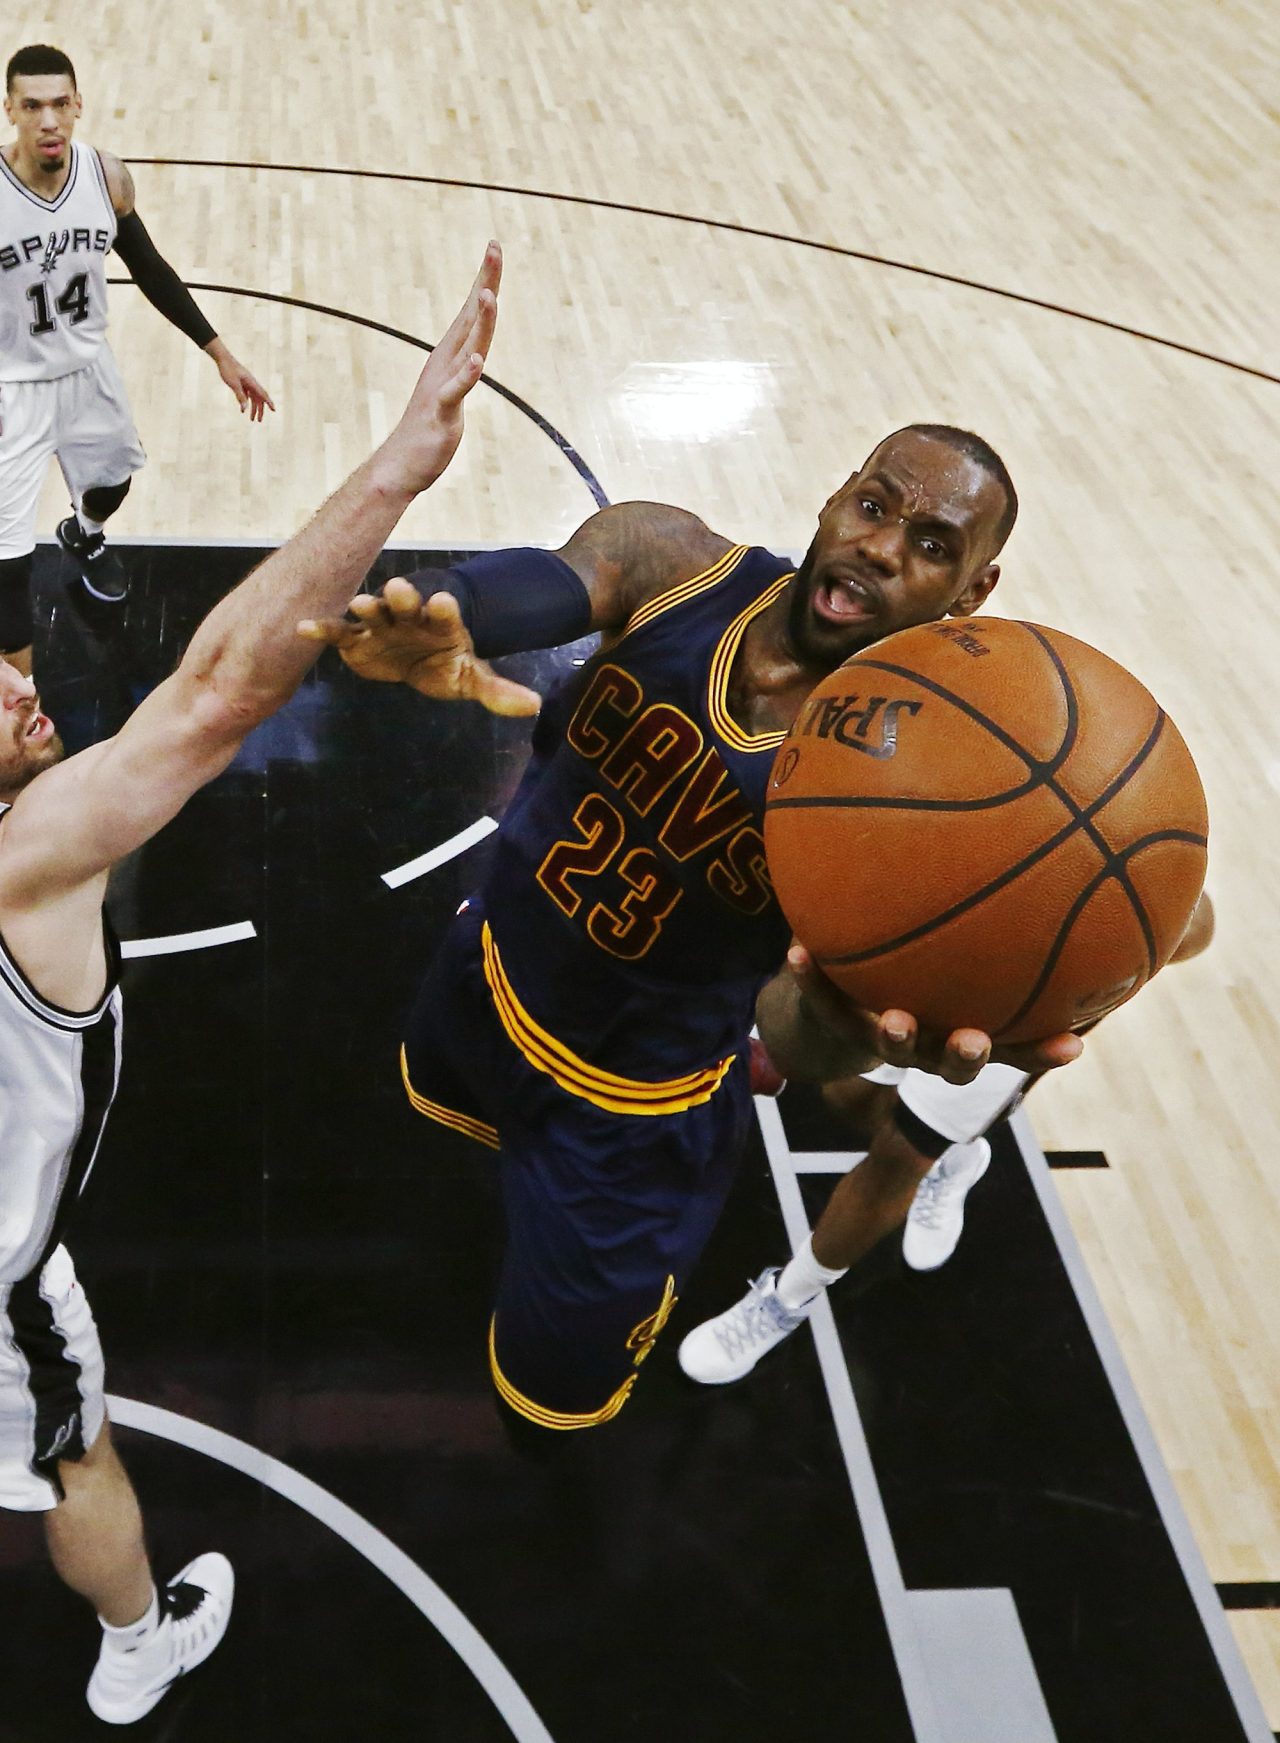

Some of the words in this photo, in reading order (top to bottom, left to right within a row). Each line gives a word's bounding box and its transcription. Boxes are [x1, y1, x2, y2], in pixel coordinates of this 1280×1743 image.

[25, 271, 91, 337] 14
[567, 663, 772, 915] CAVS
[535, 792, 684, 960] 23
